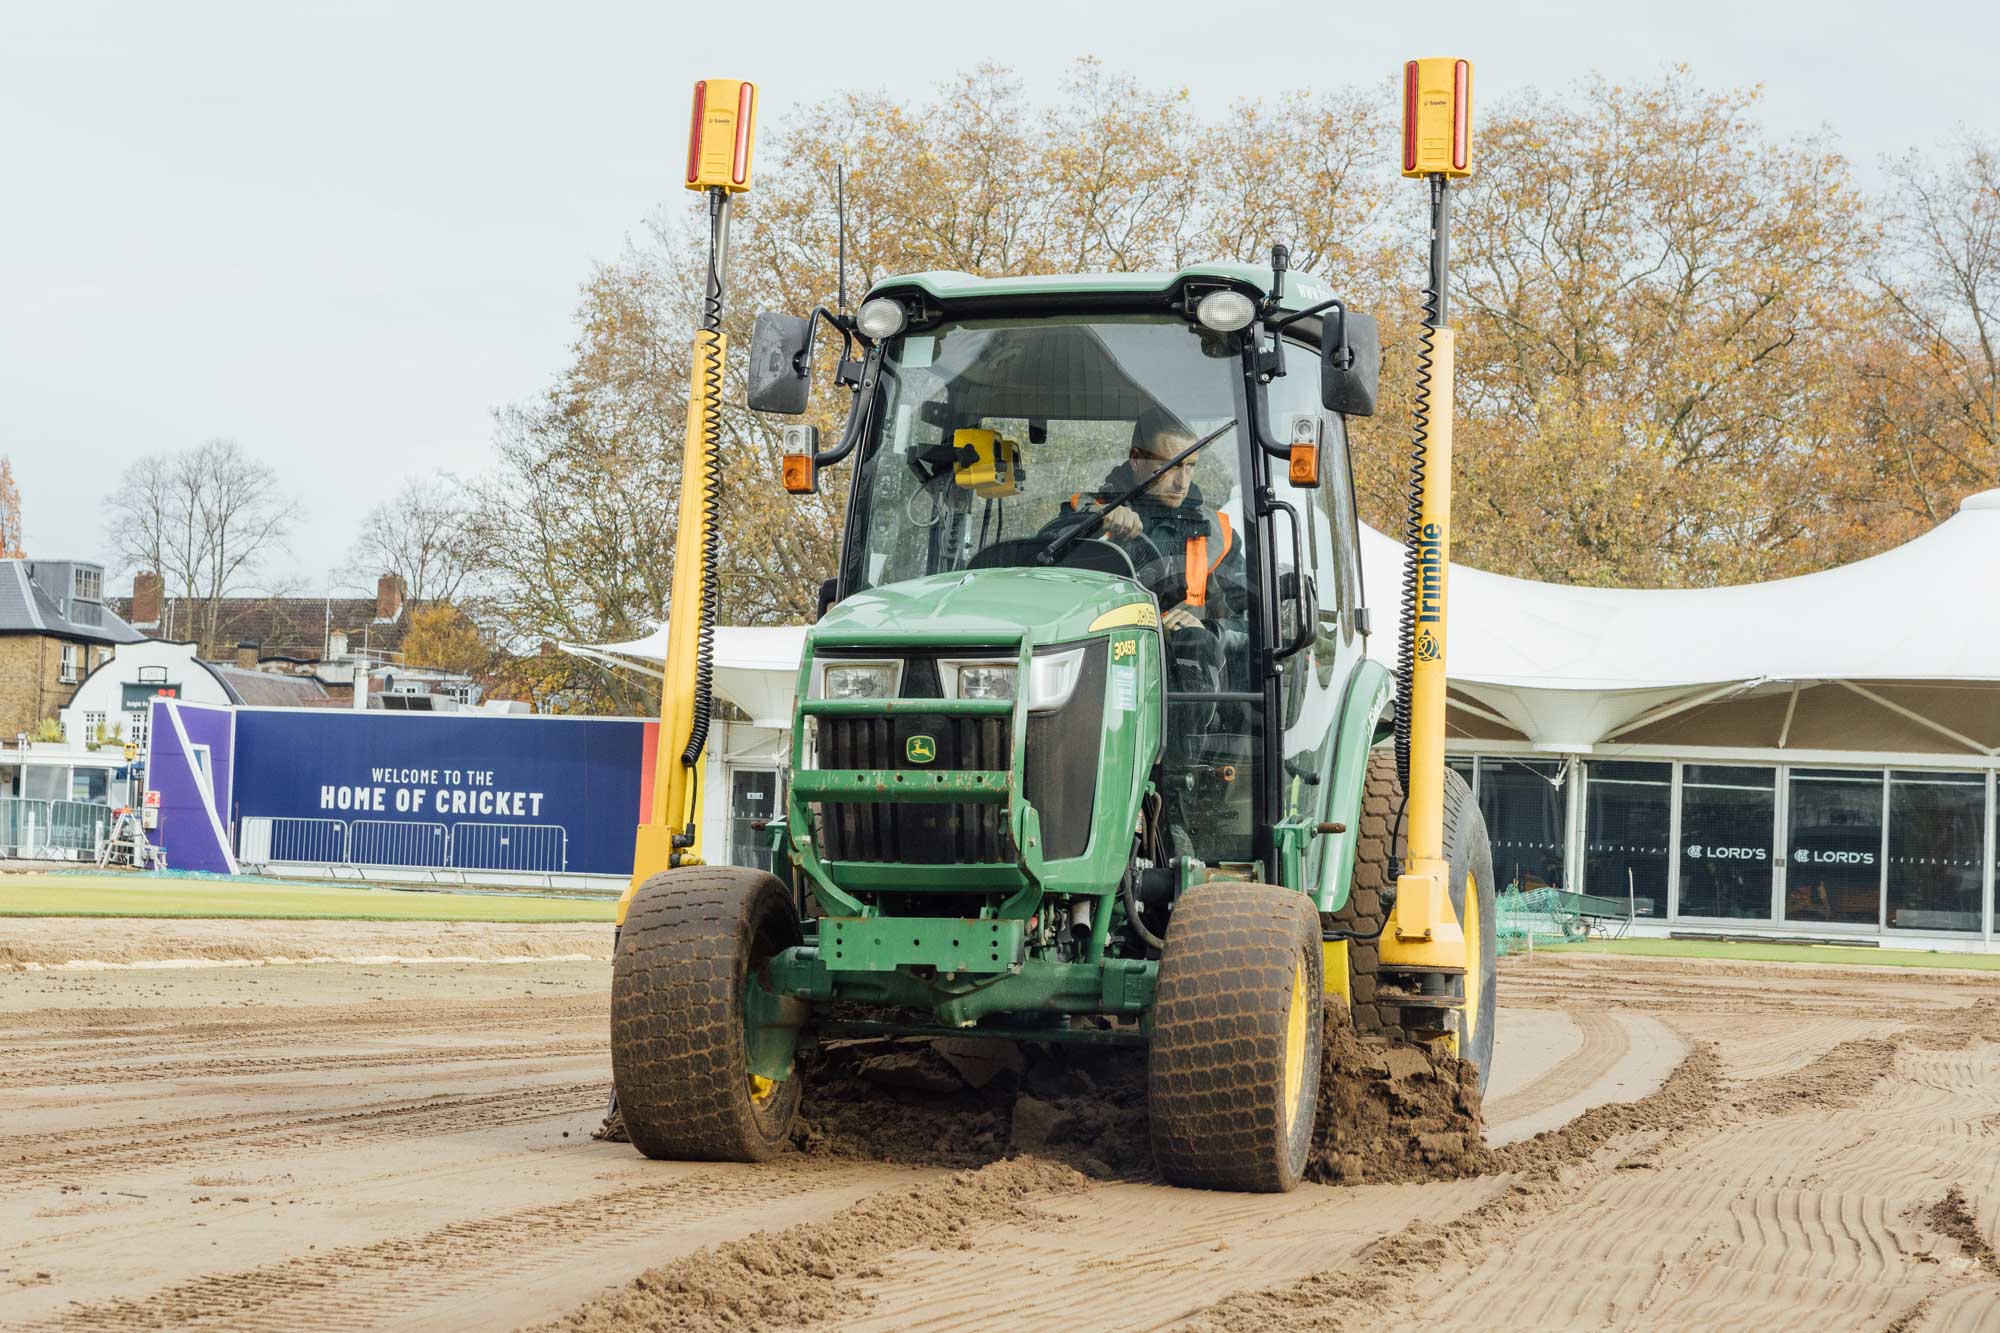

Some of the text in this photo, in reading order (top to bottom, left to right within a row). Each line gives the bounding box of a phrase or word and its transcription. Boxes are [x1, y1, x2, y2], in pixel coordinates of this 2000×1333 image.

[1113, 639, 1137, 661] 3045R
[371, 767, 494, 787] WELCOME TO THE
[320, 785, 545, 817] HOME OF CRICKET
[1706, 847, 1767, 860] LORD'S
[1813, 850, 1875, 864] LORD'S
